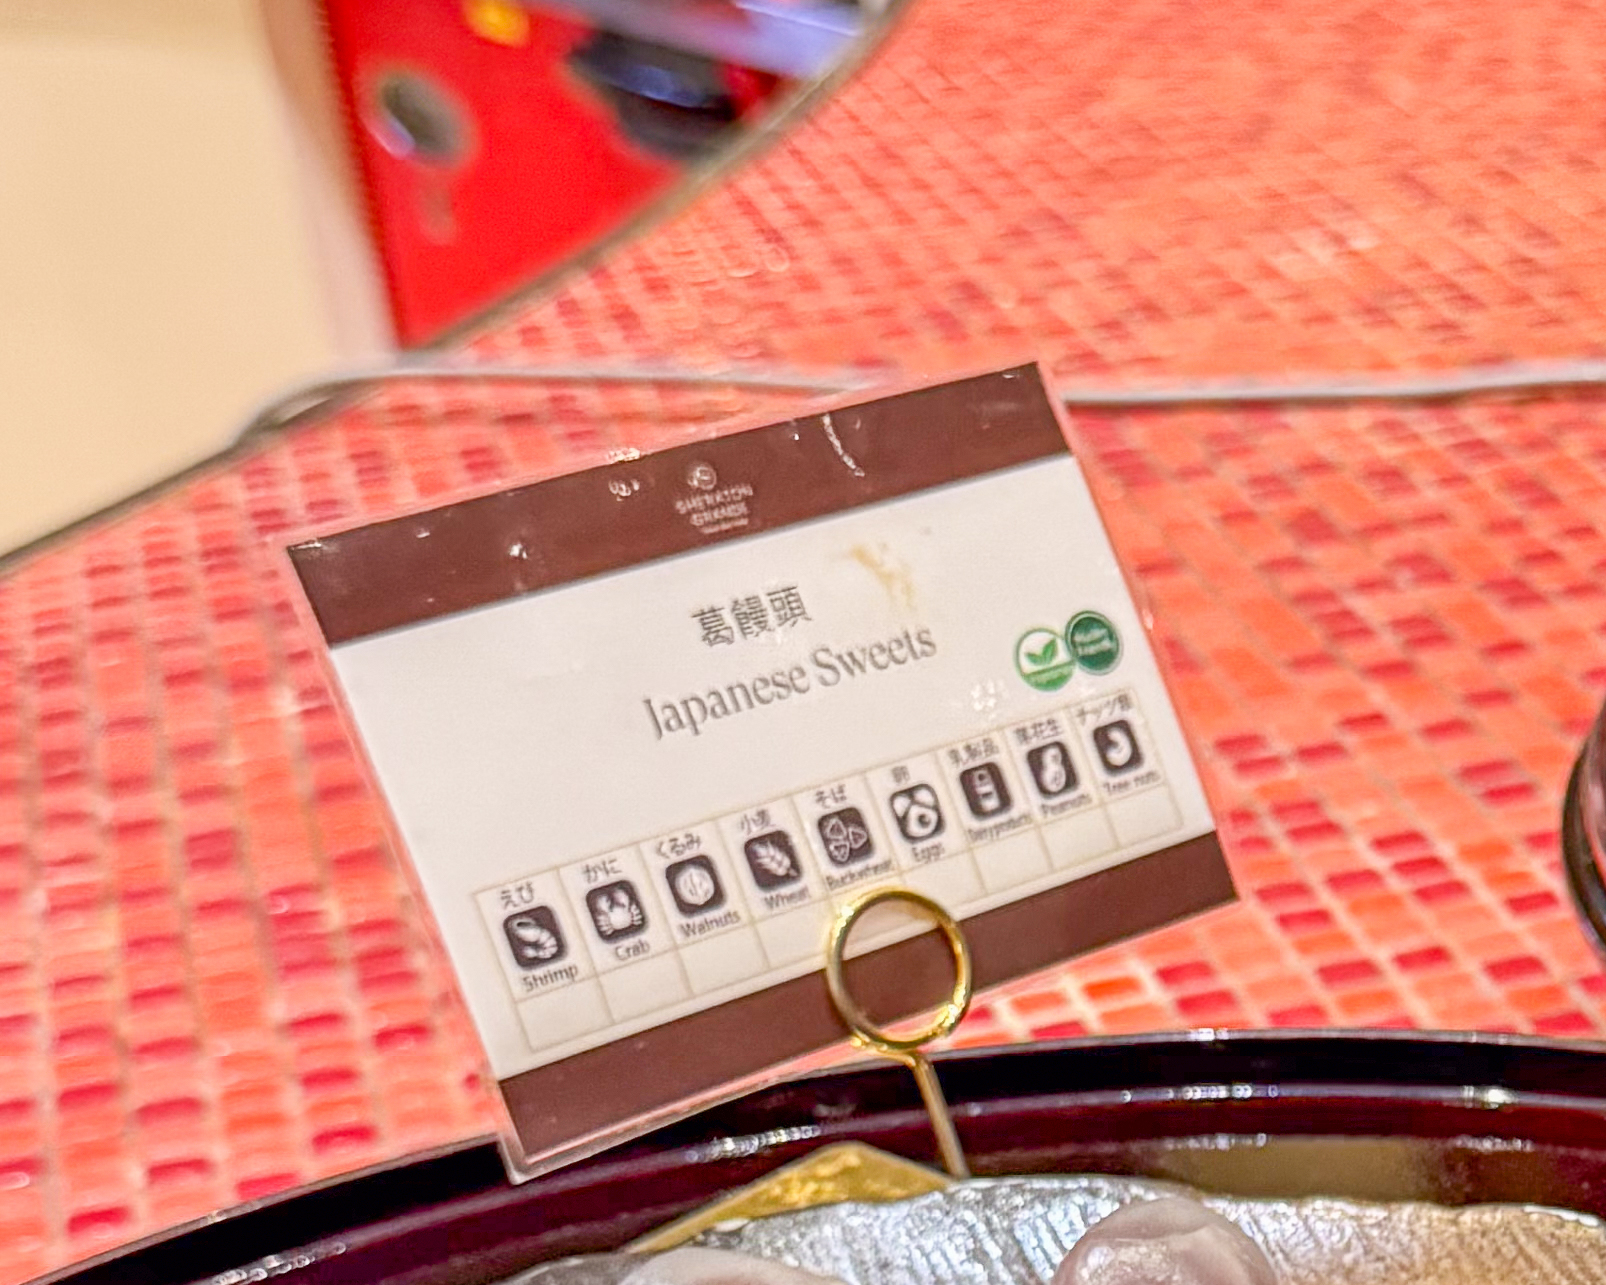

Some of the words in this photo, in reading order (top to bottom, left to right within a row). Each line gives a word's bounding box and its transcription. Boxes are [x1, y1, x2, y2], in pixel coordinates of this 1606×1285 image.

[691, 585, 813, 648] 葛饅頭
[643, 664, 811, 741] Japanese
[810, 627, 938, 688] Sweets
[656, 833, 702, 859] くるみ
[911, 842, 945, 865] Eggs
[582, 858, 623, 885] かに
[500, 881, 535, 910] えび
[763, 886, 810, 911] Wheat
[679, 910, 741, 938] Walnuts
[614, 939, 651, 962] Crab
[521, 963, 579, 993] Shrimp
